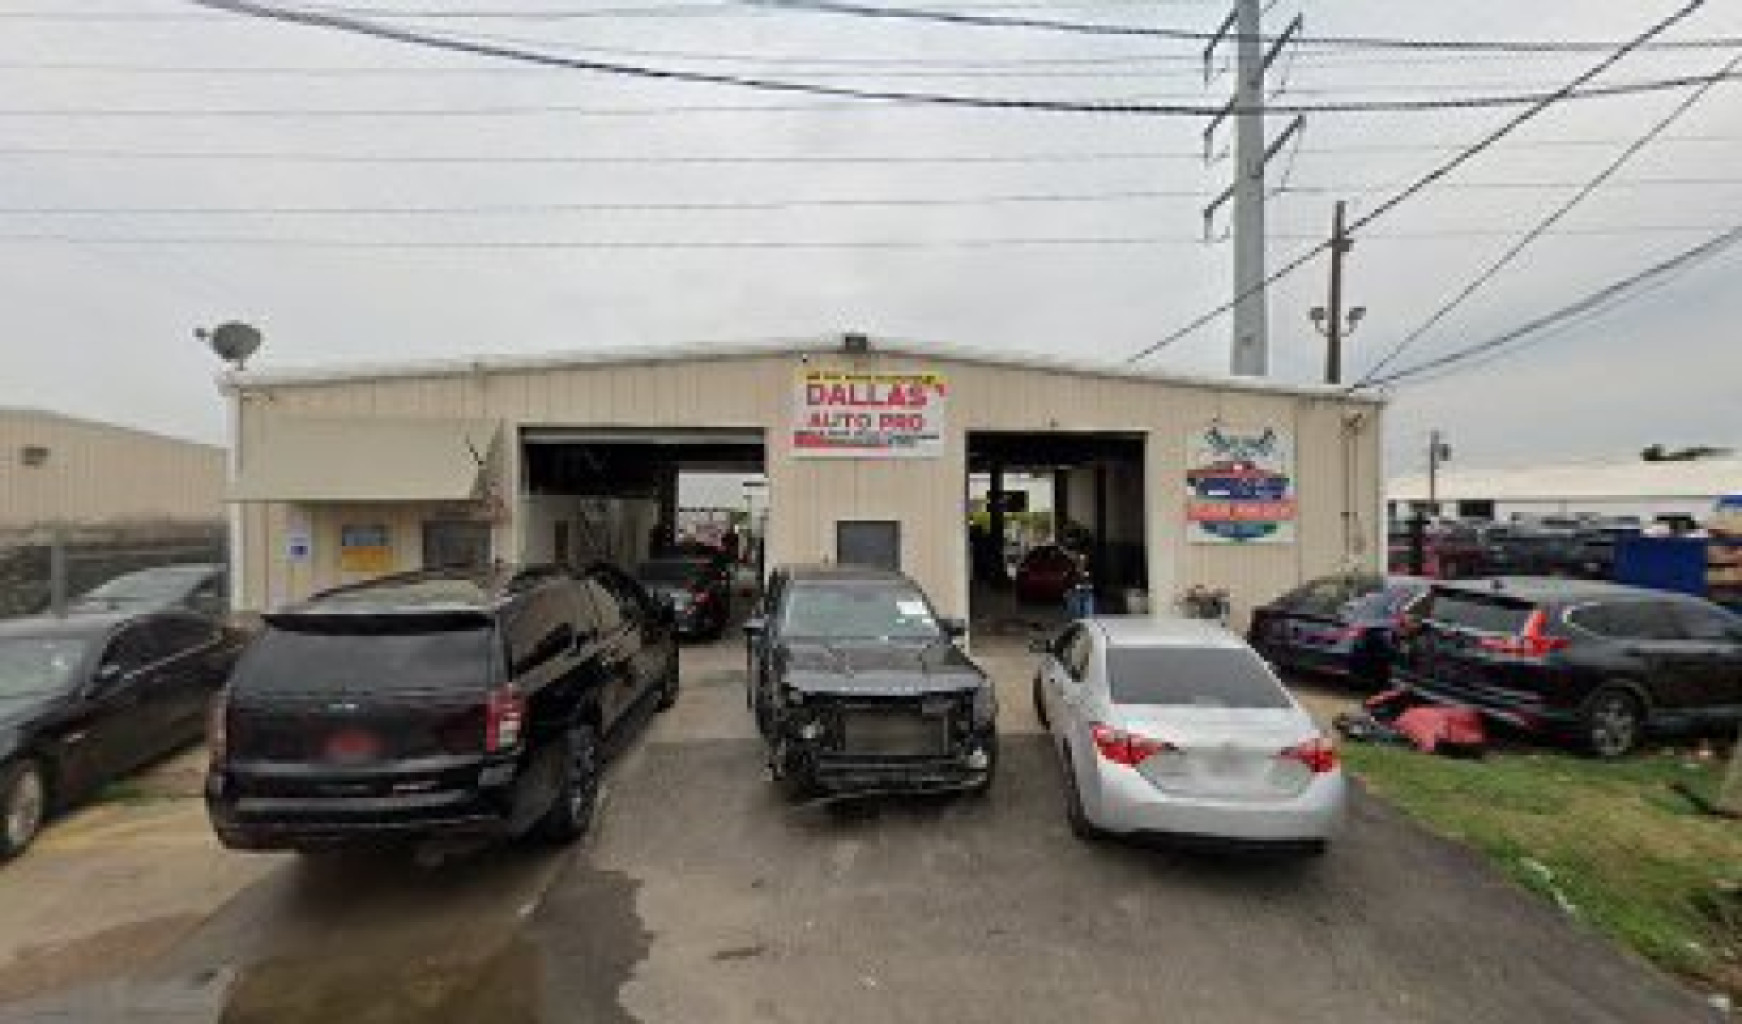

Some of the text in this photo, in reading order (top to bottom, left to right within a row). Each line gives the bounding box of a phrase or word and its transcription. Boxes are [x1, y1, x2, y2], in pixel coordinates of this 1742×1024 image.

[806, 384, 927, 406] DALLAS
[808, 413, 924, 431] AUTO PRO
